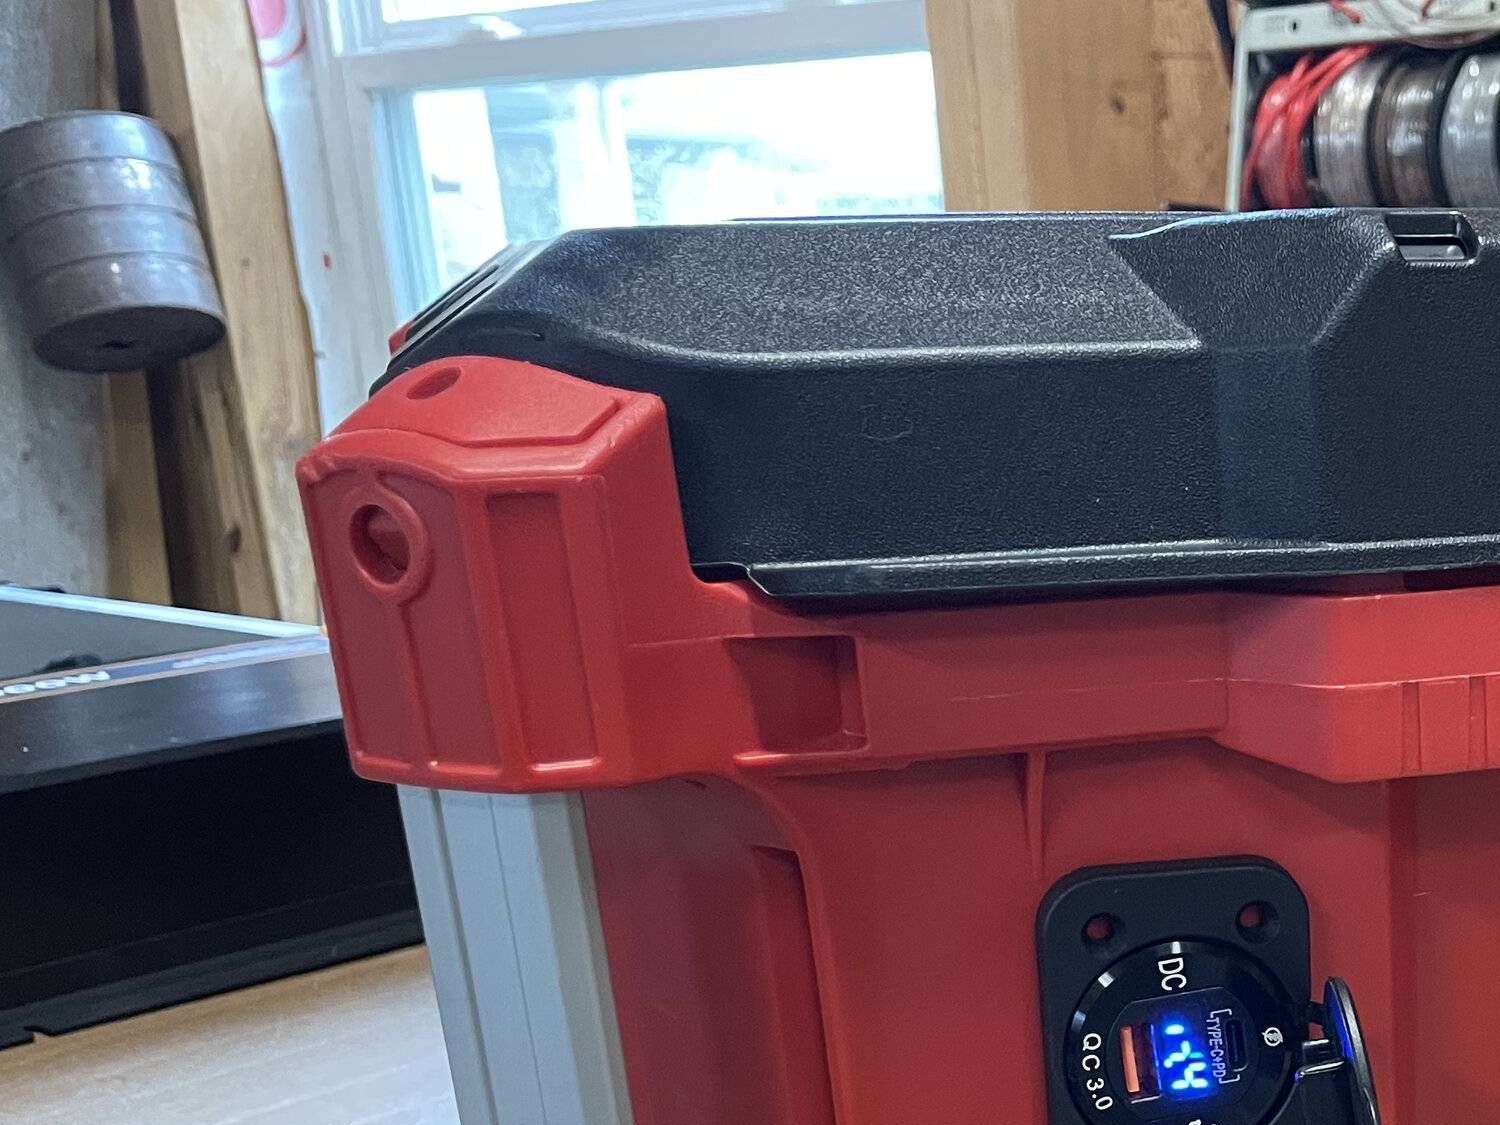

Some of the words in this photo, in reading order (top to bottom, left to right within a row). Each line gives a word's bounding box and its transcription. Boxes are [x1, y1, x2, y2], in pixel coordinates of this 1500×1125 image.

[1157, 957, 1187, 991] DC
[1081, 1033, 1102, 1072] QC
[1085, 1077, 1113, 1110] 3.0
